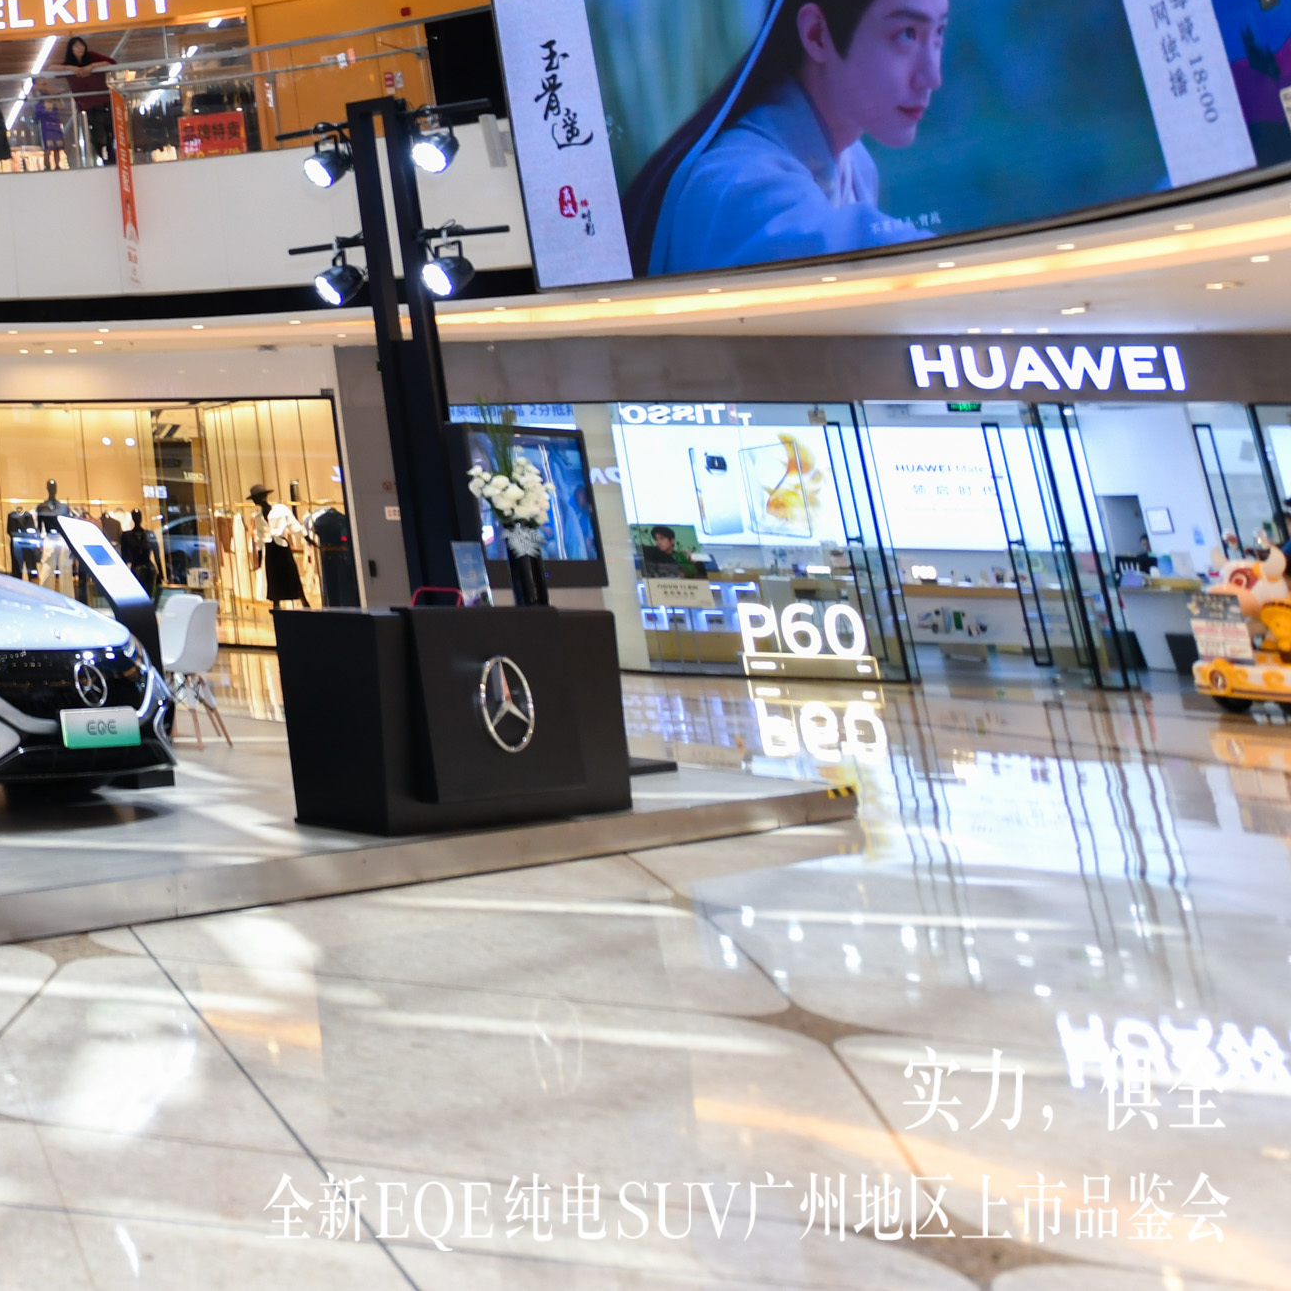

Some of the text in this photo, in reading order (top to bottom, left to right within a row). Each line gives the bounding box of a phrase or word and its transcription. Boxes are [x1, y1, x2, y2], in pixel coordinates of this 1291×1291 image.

[534, 39, 594, 150] 玉骨遥
[1188, 56, 1219, 124] 18:00
[184, 122, 241, 141] 品牌特卖
[910, 344, 1186, 391] HUAWEI
[895, 464, 951, 473] HUAWEI
[737, 602, 867, 657] P60
[87, 719, 117, 735] EQE
